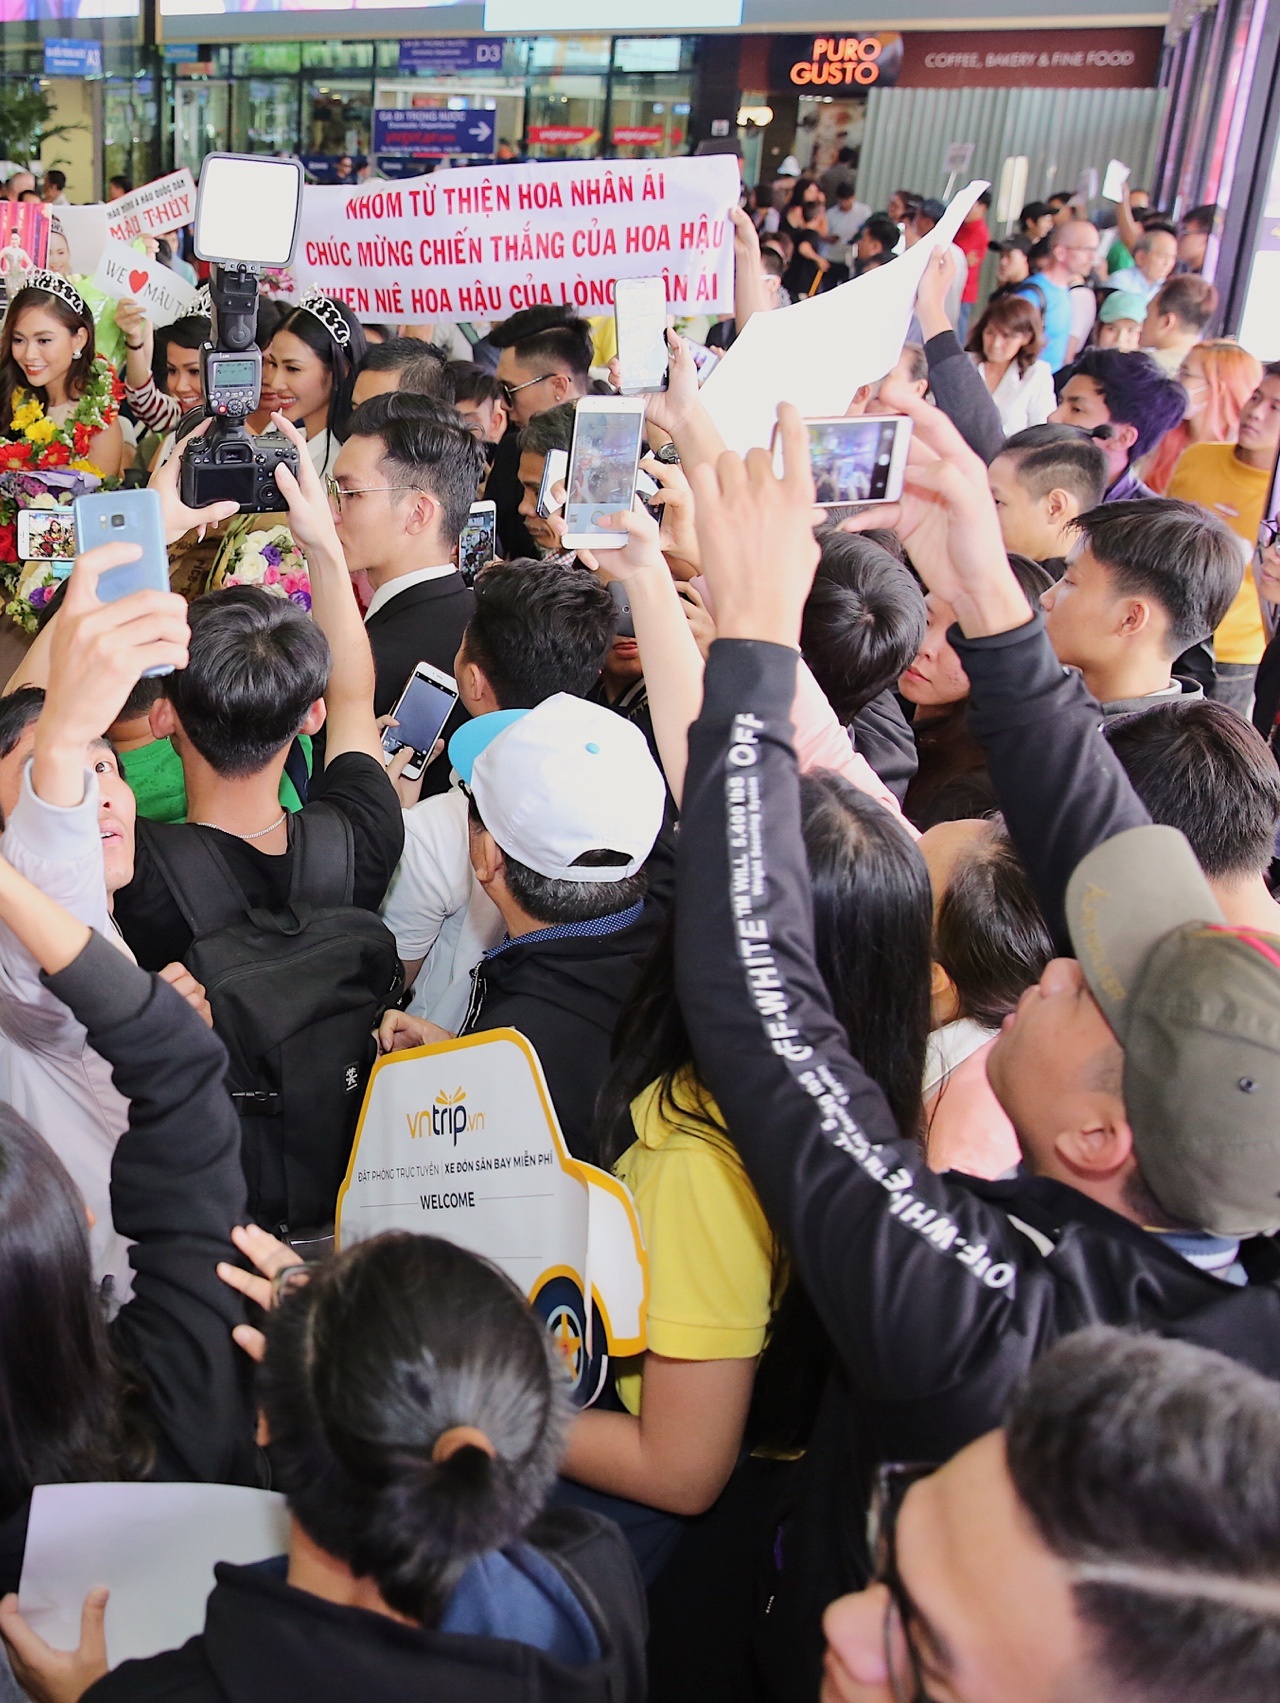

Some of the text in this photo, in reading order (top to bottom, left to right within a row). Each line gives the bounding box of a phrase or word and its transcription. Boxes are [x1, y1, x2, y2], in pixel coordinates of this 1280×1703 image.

[476, 44, 500, 62] D3
[812, 37, 882, 62] PURO
[924, 50, 1135, 69] COFFEE, BAKERY & FINE FOOD
[789, 61, 880, 85] GUSTO
[346, 168, 665, 219] NHÓM TỪ THIỆN HOA NHÂN ÁI
[142, 194, 191, 228] THỦY
[306, 213, 724, 267] CHÚC MỪNG CHIẾN THẮNG CỦA HOA HẬU
[106, 259, 127, 285] WE
[375, 282, 404, 314] NIÊ
[412, 288, 453, 314] HOA
[459, 279, 501, 316] HẬU
[509, 273, 552, 310] CỦA
[696, 266, 717, 301] ÁI
[728, 713, 765, 767] OFF
[732, 853, 751, 893] WILL
[406, 1104, 485, 1147] vntrip.vn
[372, 1166, 395, 1182] PHÒNG
[396, 1164, 415, 1181] TRỰC
[444, 1162, 456, 1175] XE
[456, 1157, 474, 1173] ĐÓN
[475, 1156, 492, 1172] SÂN
[494, 1157, 512, 1170] BAY
[513, 1150, 536, 1168] MIỄN
[538, 1150, 553, 1166] PHÍ
[420, 1191, 476, 1210] WELCOME
